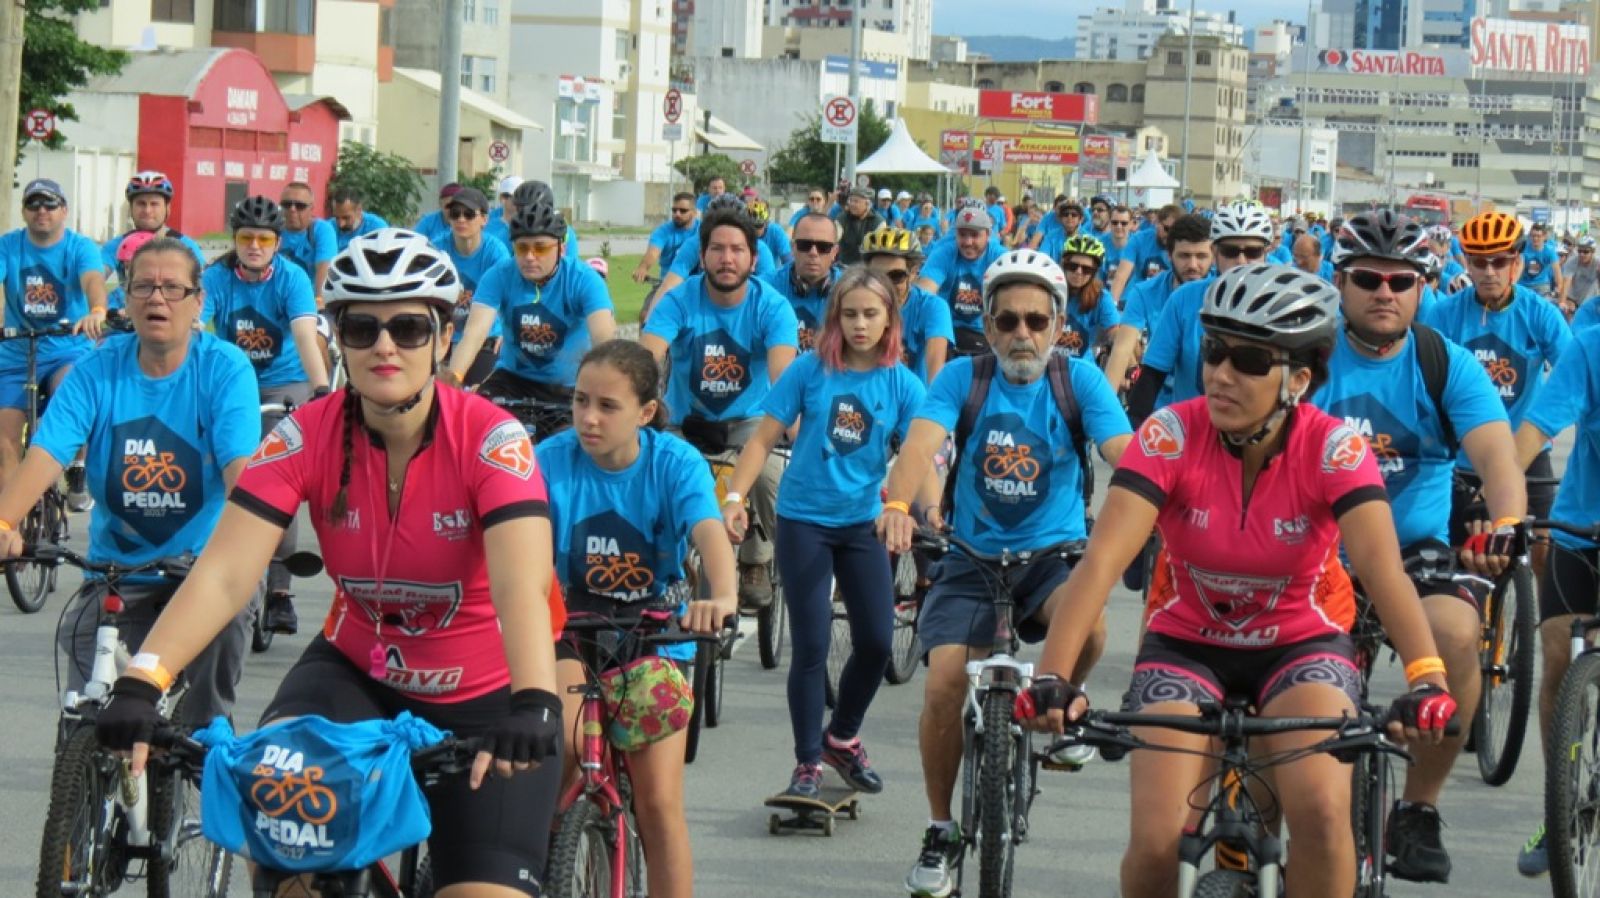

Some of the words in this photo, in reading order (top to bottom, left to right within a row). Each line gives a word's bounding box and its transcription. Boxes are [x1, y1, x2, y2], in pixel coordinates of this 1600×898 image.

[1471, 16, 1537, 72] SANTA
[1545, 23, 1590, 75] RITA
[1352, 49, 1404, 73] SANTA
[1405, 51, 1445, 76] RITA
[1011, 92, 1053, 109] Fort
[943, 132, 968, 144] Fort
[1084, 137, 1109, 149] Fort
[26, 275, 44, 286] DIA
[25, 303, 57, 315] PEDAL
[237, 319, 256, 331] DIA
[521, 314, 540, 326] DIA
[704, 344, 726, 357] DIA
[1475, 349, 1498, 362] DIA
[700, 380, 742, 393] PEDAL
[838, 402, 854, 414] DIA
[832, 427, 862, 441] PEDAL
[986, 430, 1015, 448] DIA
[125, 438, 157, 456] DIA
[125, 455, 139, 465] DO
[984, 476, 1037, 496] PEDAL
[123, 491, 187, 509] PEDAL
[586, 536, 621, 557] DIA
[586, 555, 603, 565] DO
[261, 744, 304, 774] DIA
[252, 763, 276, 778] DO
[256, 809, 335, 848] PEDAL
